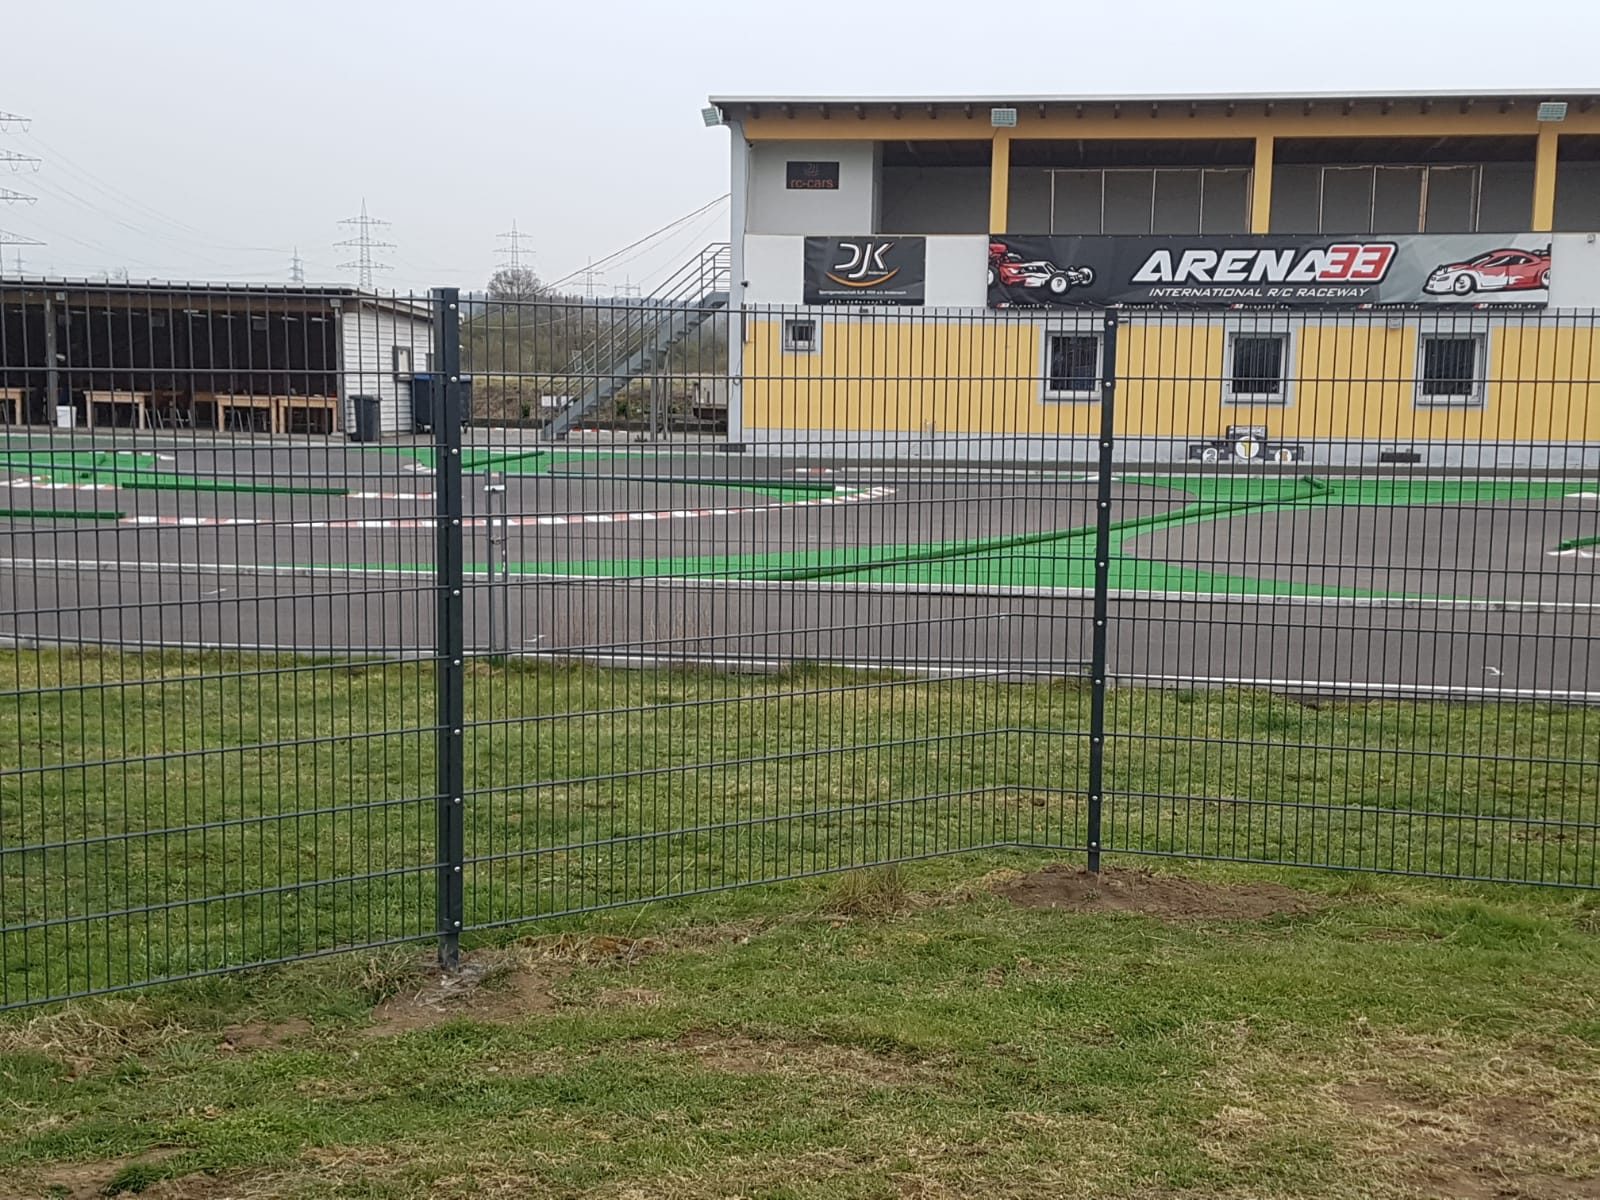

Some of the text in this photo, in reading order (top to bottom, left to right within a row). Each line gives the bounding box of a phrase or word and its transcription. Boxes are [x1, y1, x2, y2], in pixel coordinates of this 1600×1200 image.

[790, 179, 834, 188] rc-cars
[834, 242, 893, 278] DJK
[1148, 287, 1370, 297] INTERNATIONAL R/C RACEWAY
